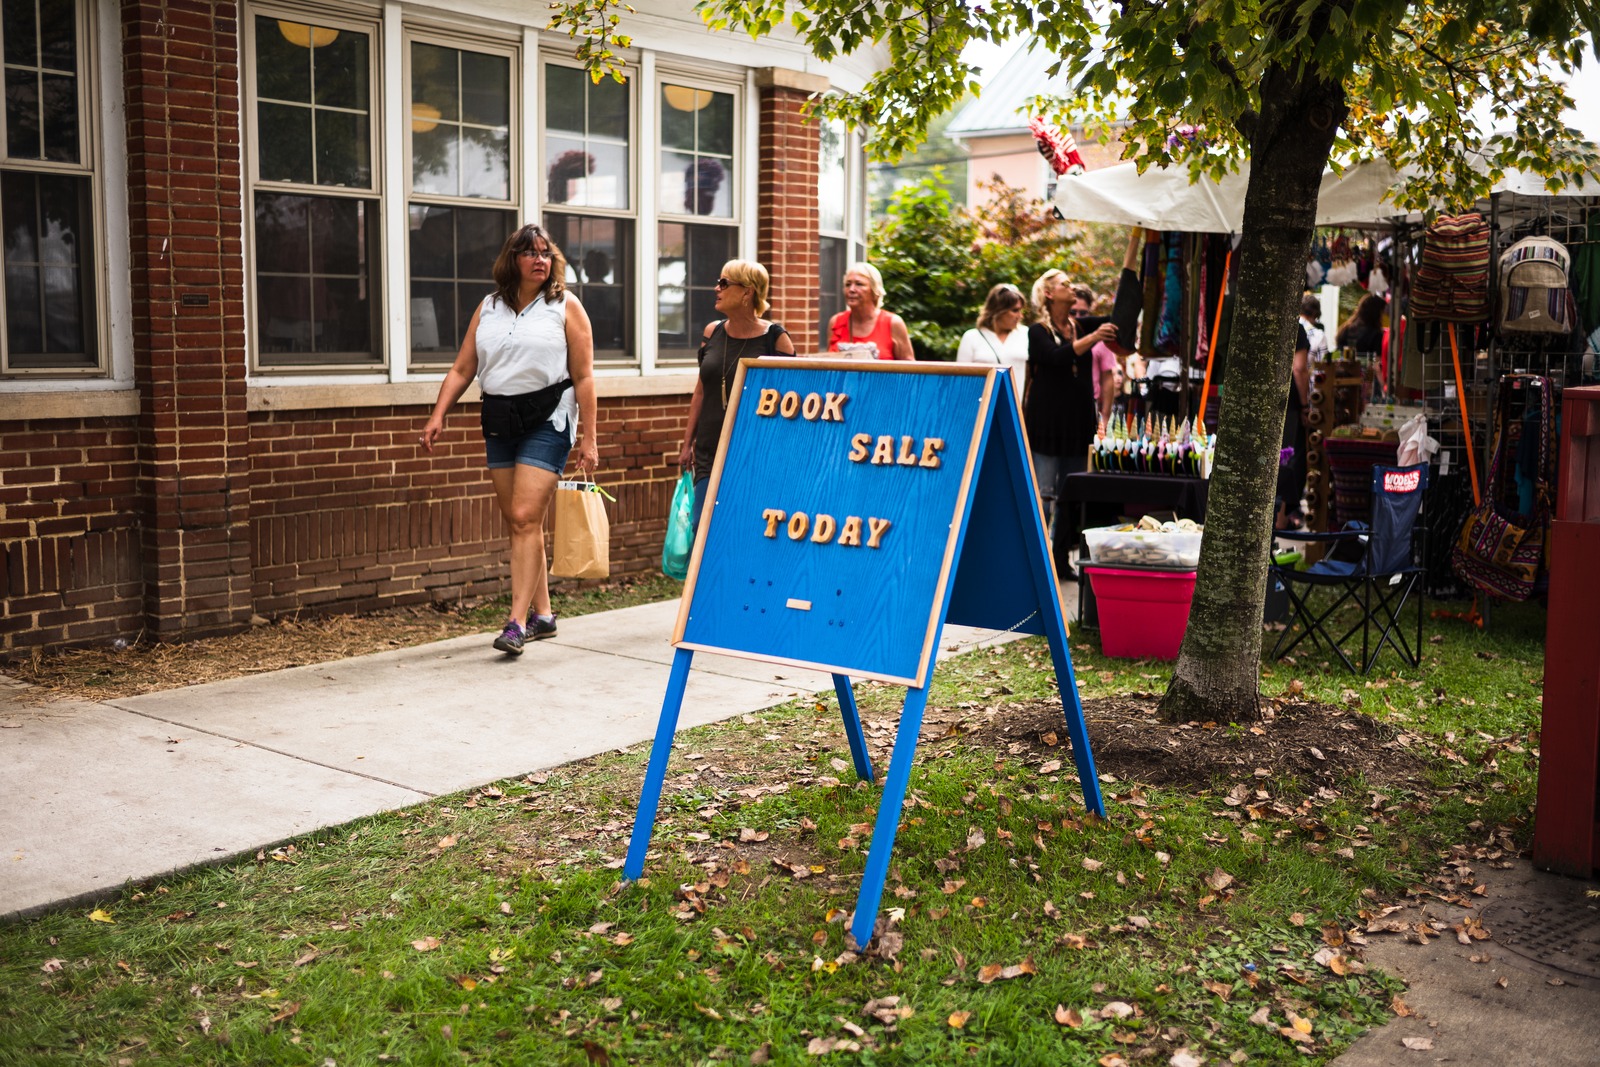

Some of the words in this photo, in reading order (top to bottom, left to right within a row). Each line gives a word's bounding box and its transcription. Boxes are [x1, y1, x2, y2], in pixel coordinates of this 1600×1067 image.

[756, 388, 848, 422] BOOK
[848, 433, 944, 469] SALE
[762, 508, 891, 548] TODAY
